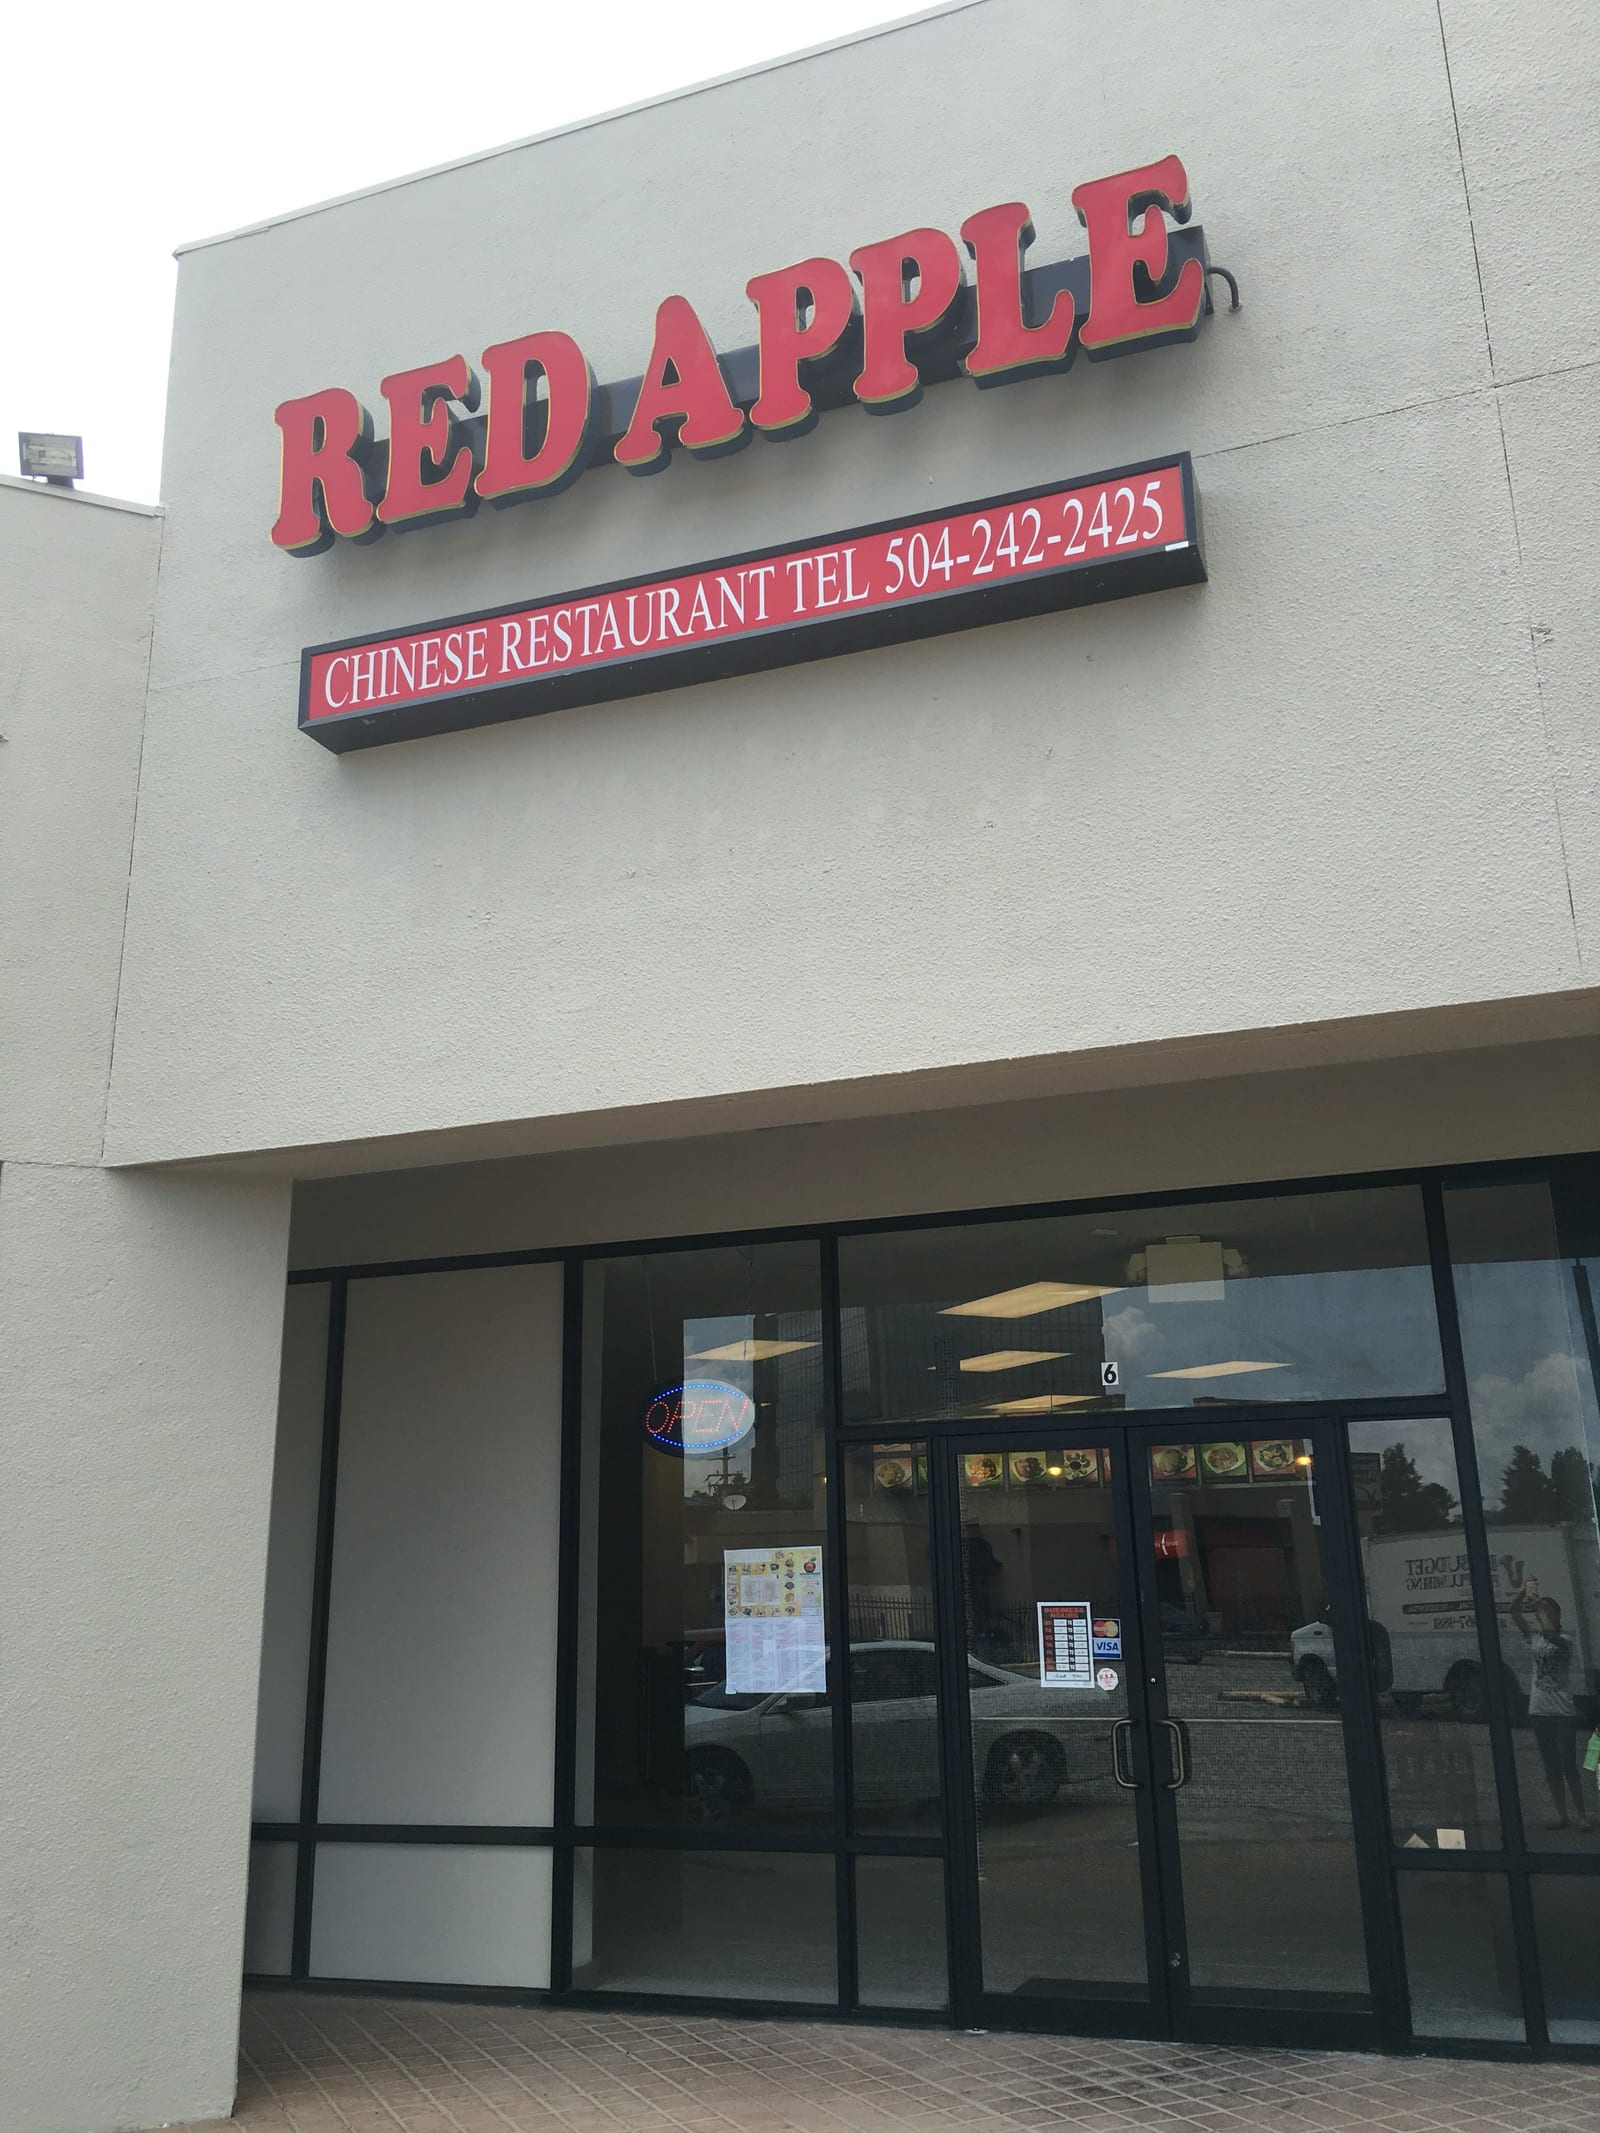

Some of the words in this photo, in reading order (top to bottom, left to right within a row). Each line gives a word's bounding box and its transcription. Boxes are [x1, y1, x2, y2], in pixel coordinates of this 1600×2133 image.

[271, 329, 590, 550] RED
[614, 154, 1203, 464] APPLE
[324, 627, 489, 709] CHINESE
[498, 565, 776, 674] RESTAURANT
[786, 547, 870, 613] TEL
[885, 480, 1163, 594] 504-242-2425
[1103, 1363, 1117, 1384] 6
[645, 1398, 750, 1434] OPEN
[1096, 1642, 1119, 1651] VISA
